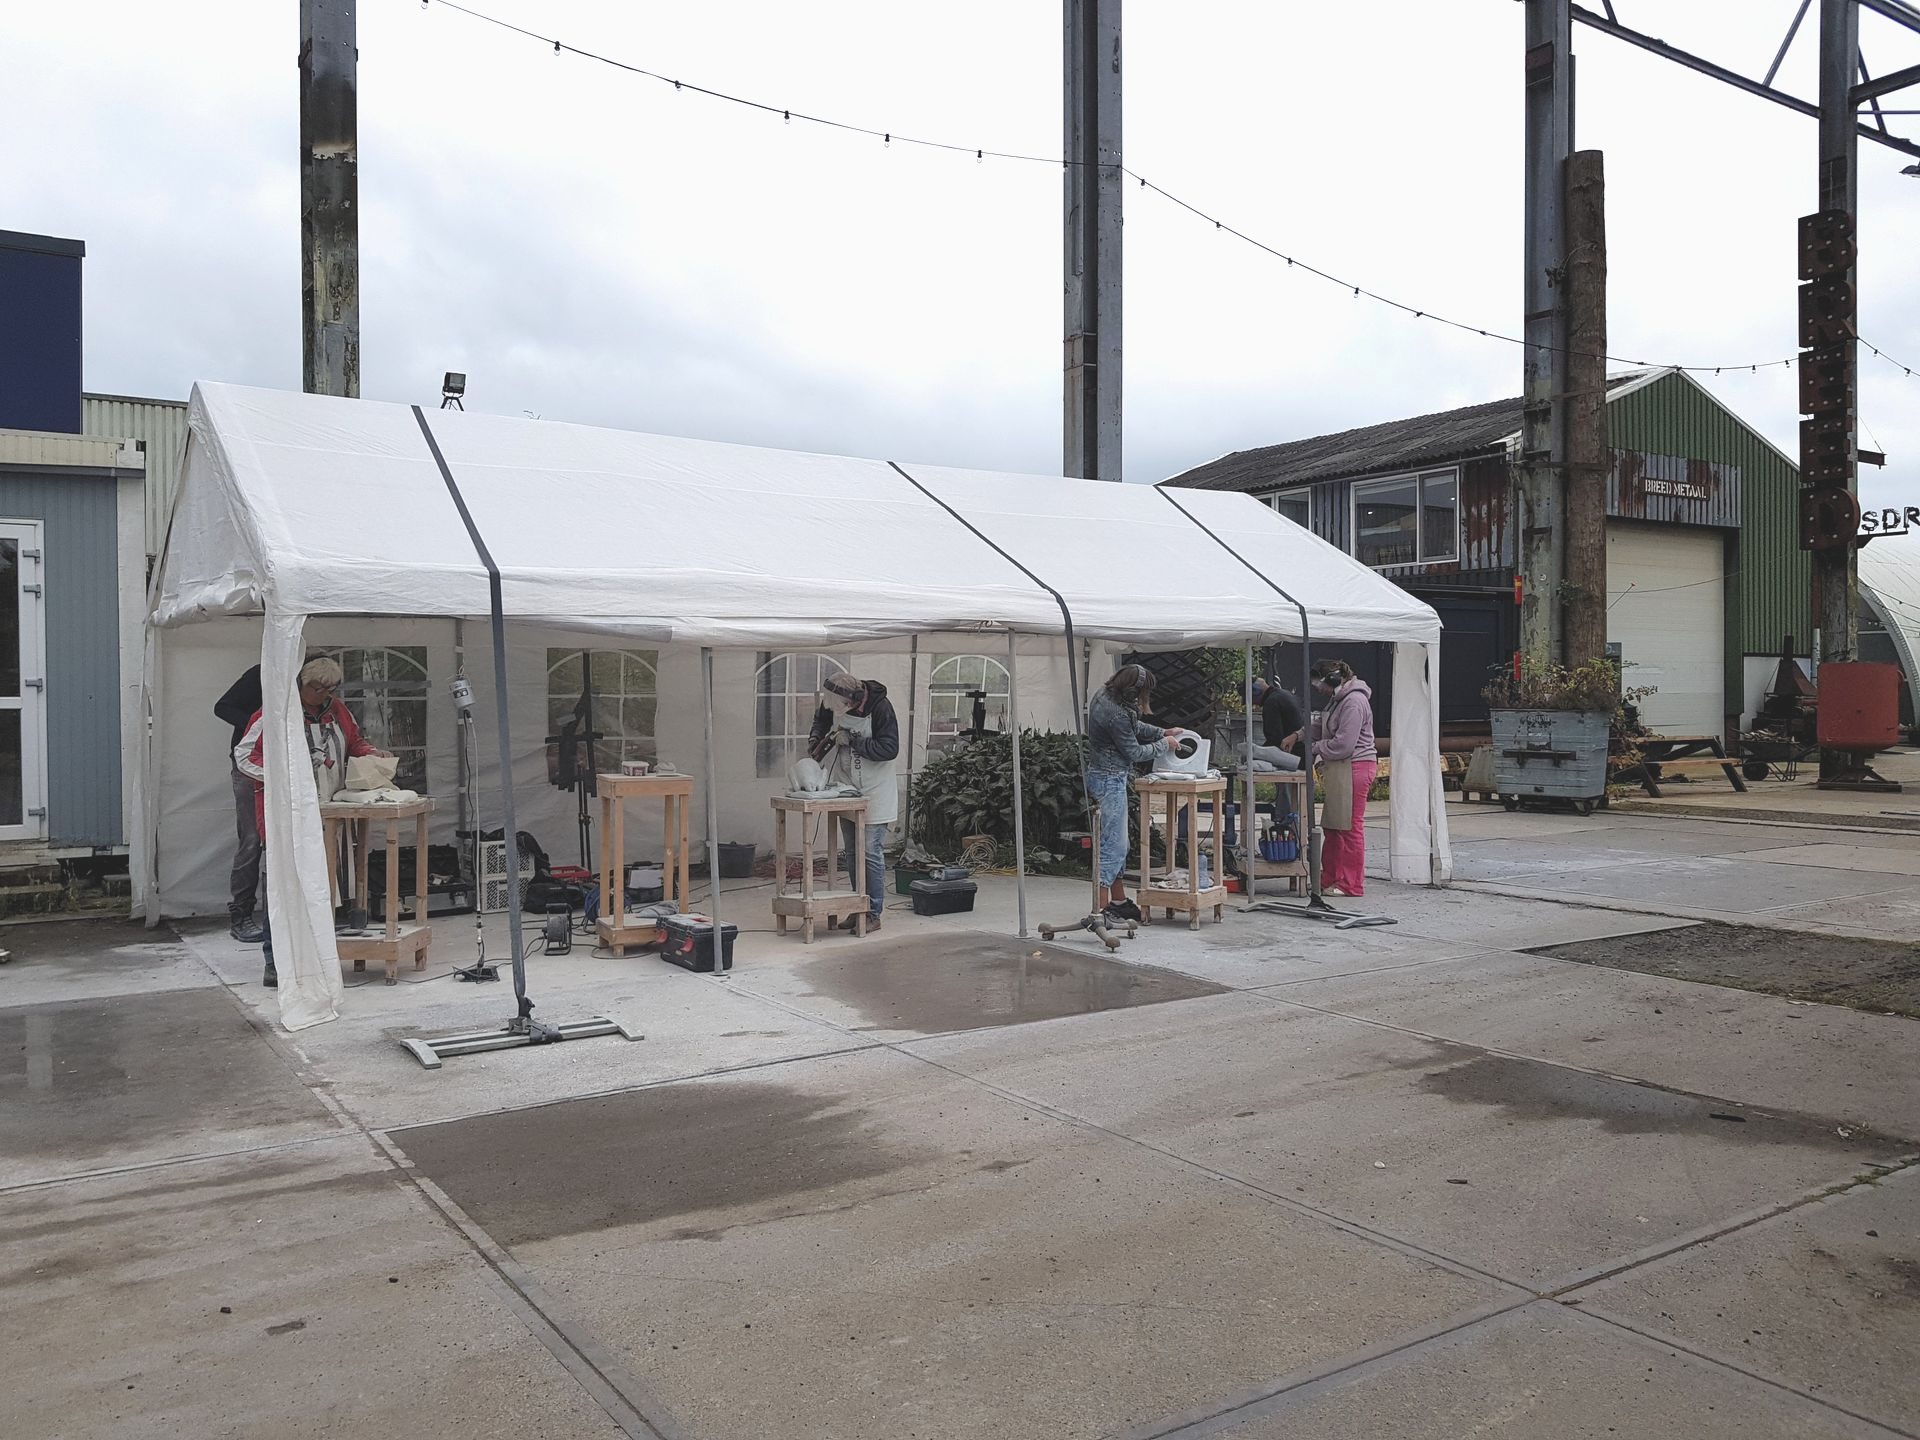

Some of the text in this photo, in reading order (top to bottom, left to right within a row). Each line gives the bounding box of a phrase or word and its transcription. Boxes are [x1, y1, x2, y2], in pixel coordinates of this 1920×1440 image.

[1798, 209, 1861, 550] BREED
[1645, 479, 1707, 499] BREED METAAL
